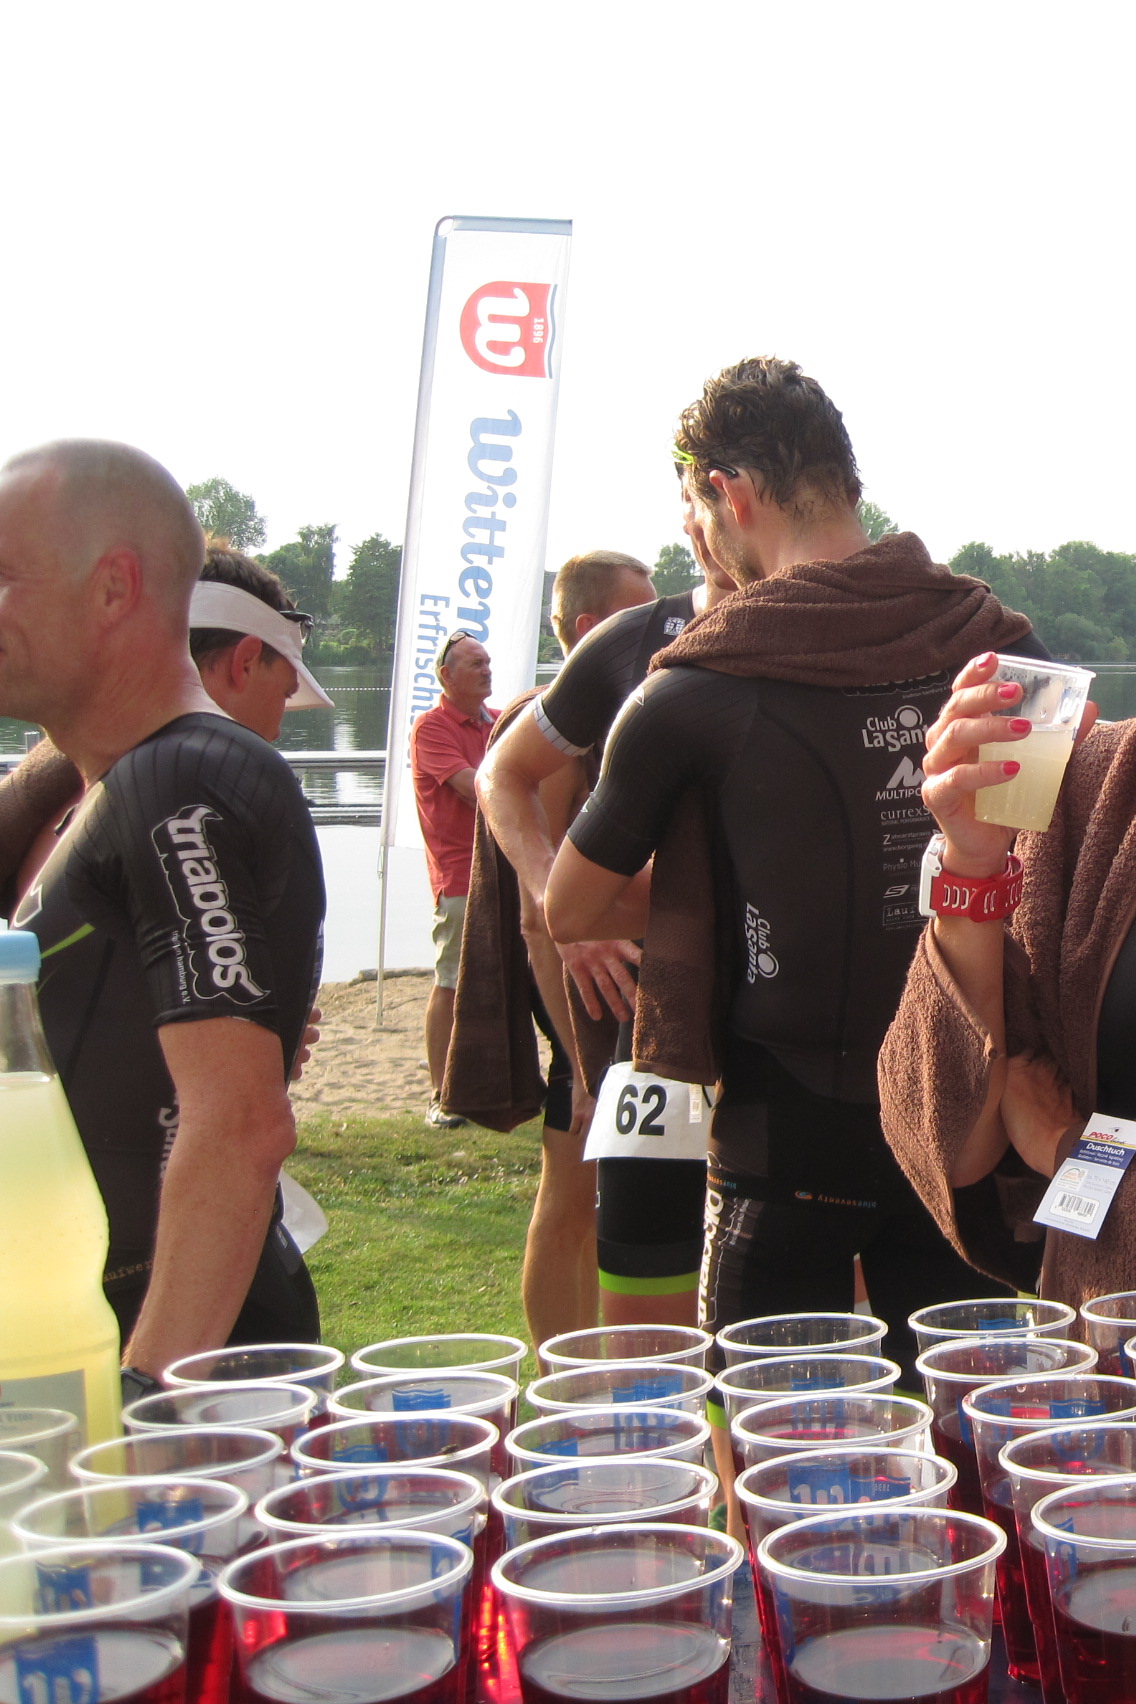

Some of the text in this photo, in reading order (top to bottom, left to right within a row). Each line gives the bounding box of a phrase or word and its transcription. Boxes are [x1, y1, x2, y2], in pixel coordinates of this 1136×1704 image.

[532, 317, 544, 345] 1896
[866, 716, 897, 732] Club
[164, 806, 265, 997] triabolos
[758, 918, 771, 949] Club
[177, 955, 188, 990] hamburg
[616, 1084, 667, 1136] 62
[1086, 1142, 1125, 1156] Duschtuch
[817, 1193, 877, 1209] blueseventy
